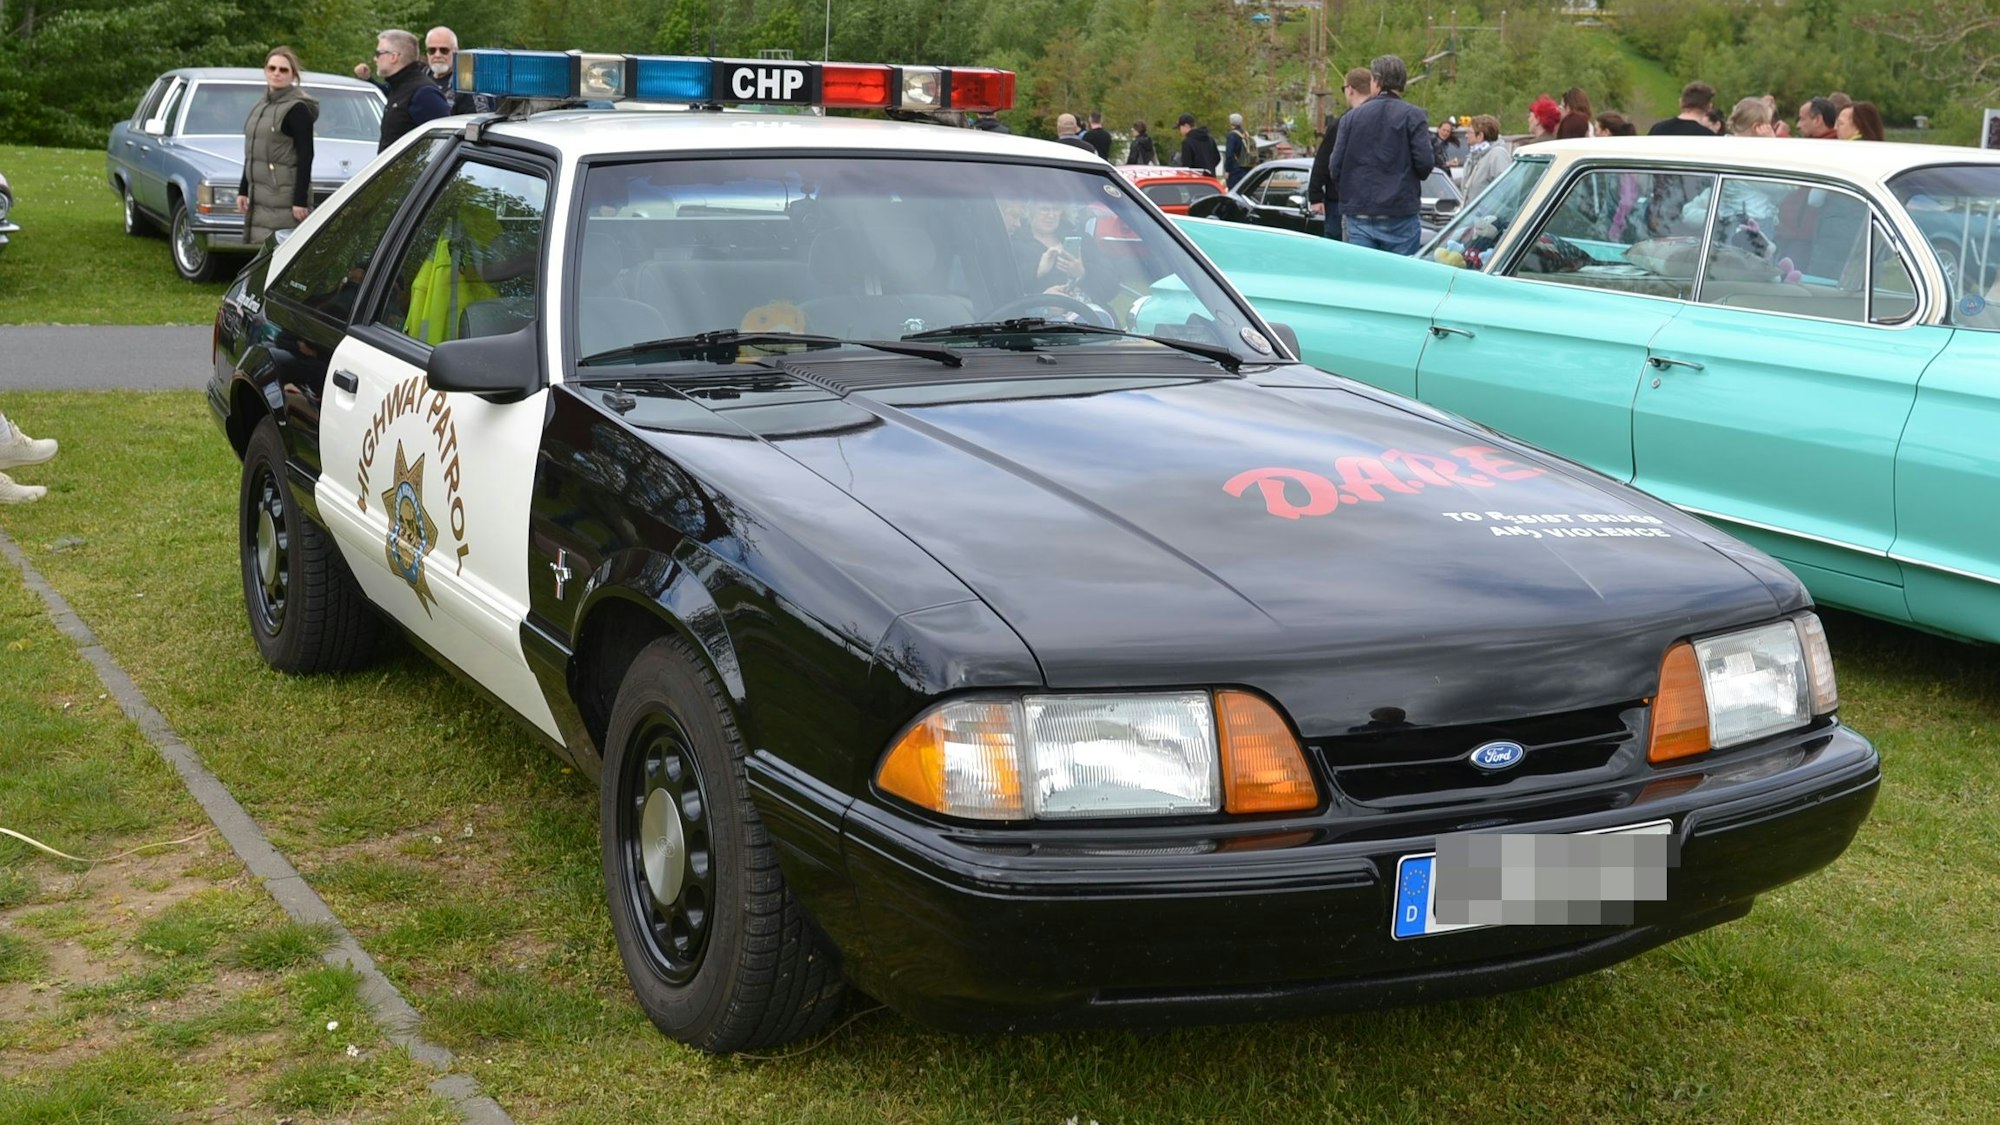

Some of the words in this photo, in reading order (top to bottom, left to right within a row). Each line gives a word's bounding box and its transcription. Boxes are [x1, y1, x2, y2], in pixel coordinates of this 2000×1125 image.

[732, 67, 804, 100] CHP
[357, 375, 430, 514] HIGHWAY
[426, 390, 469, 577] PATROL
[1442, 511, 1483, 522] TO
[1577, 513, 1664, 525] DRUGS
[1541, 527, 1671, 539] VIOLENCE
[1485, 747, 1512, 763] Ford
[1406, 905, 1418, 922] D
